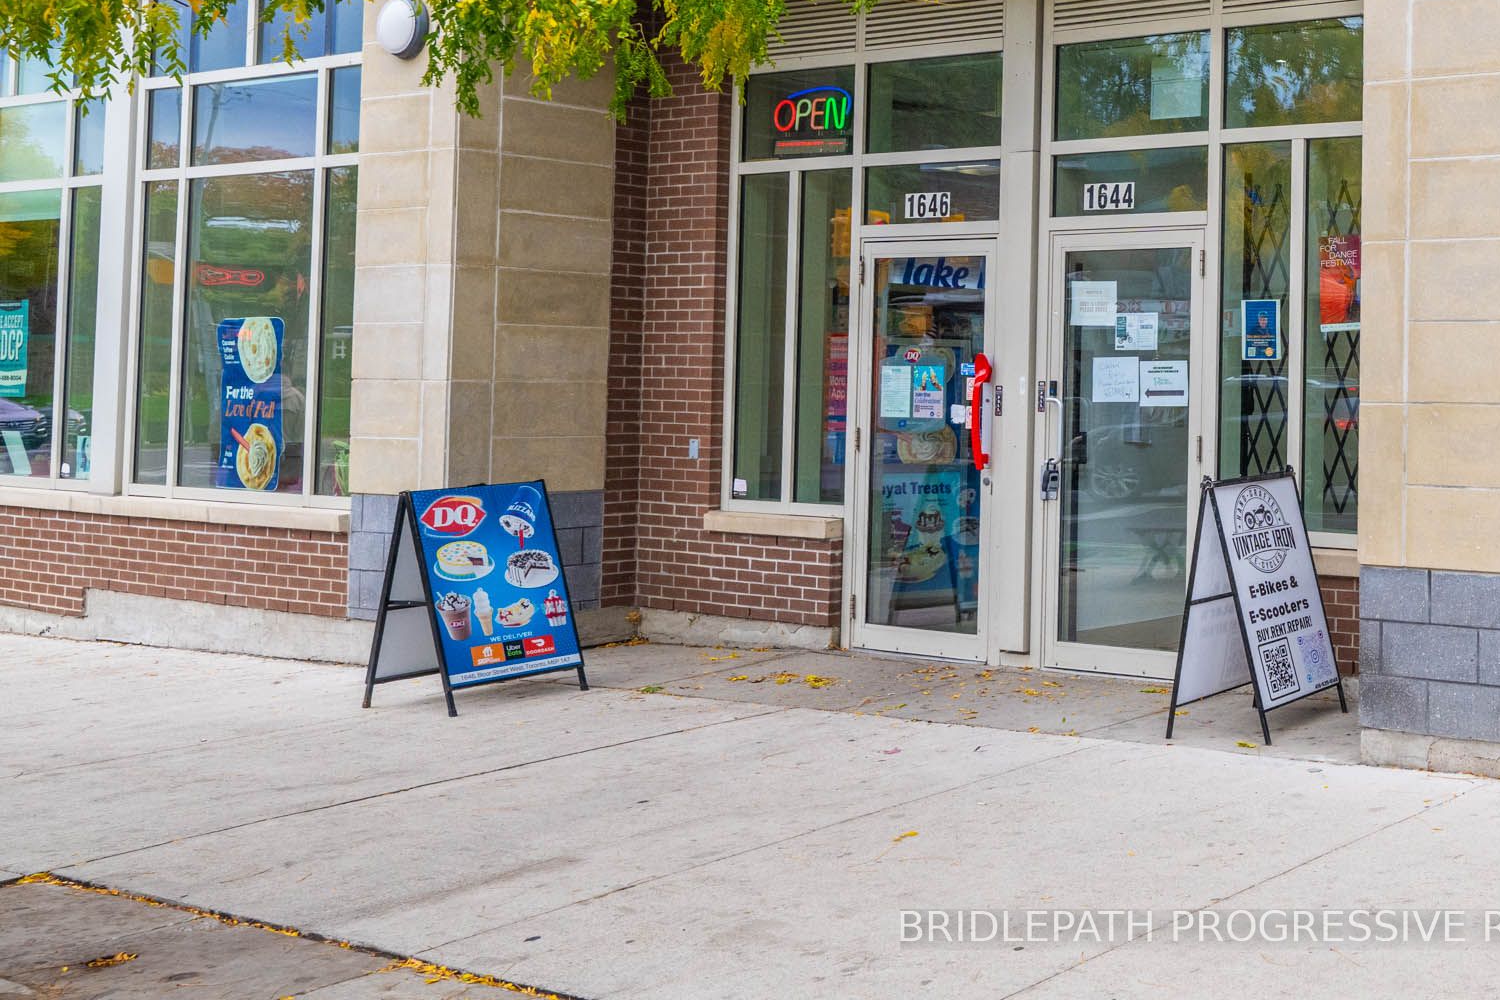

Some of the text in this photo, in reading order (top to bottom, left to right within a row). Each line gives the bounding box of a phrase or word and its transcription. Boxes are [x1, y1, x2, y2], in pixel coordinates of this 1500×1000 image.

[774, 96, 848, 131] OPEN
[907, 193, 949, 217] 1646
[1087, 184, 1133, 209] 1644
[1320, 244, 1337, 252] FOR
[1328, 236, 1347, 245] FALL
[1320, 259, 1357, 268] FESTIVAL
[1329, 250, 1358, 260] DANCE
[0, 329, 23, 360] DCP
[906, 352, 919, 360] DQ
[226, 386, 254, 399] For the
[911, 482, 952, 495] Treats
[432, 504, 477, 527] DQ
[1232, 526, 1297, 560] VINTAGE IRON
[1249, 576, 1298, 599] E-Bikes &
[1249, 598, 1309, 624] E-Scooters
[503, 631, 533, 641] DELIVER
